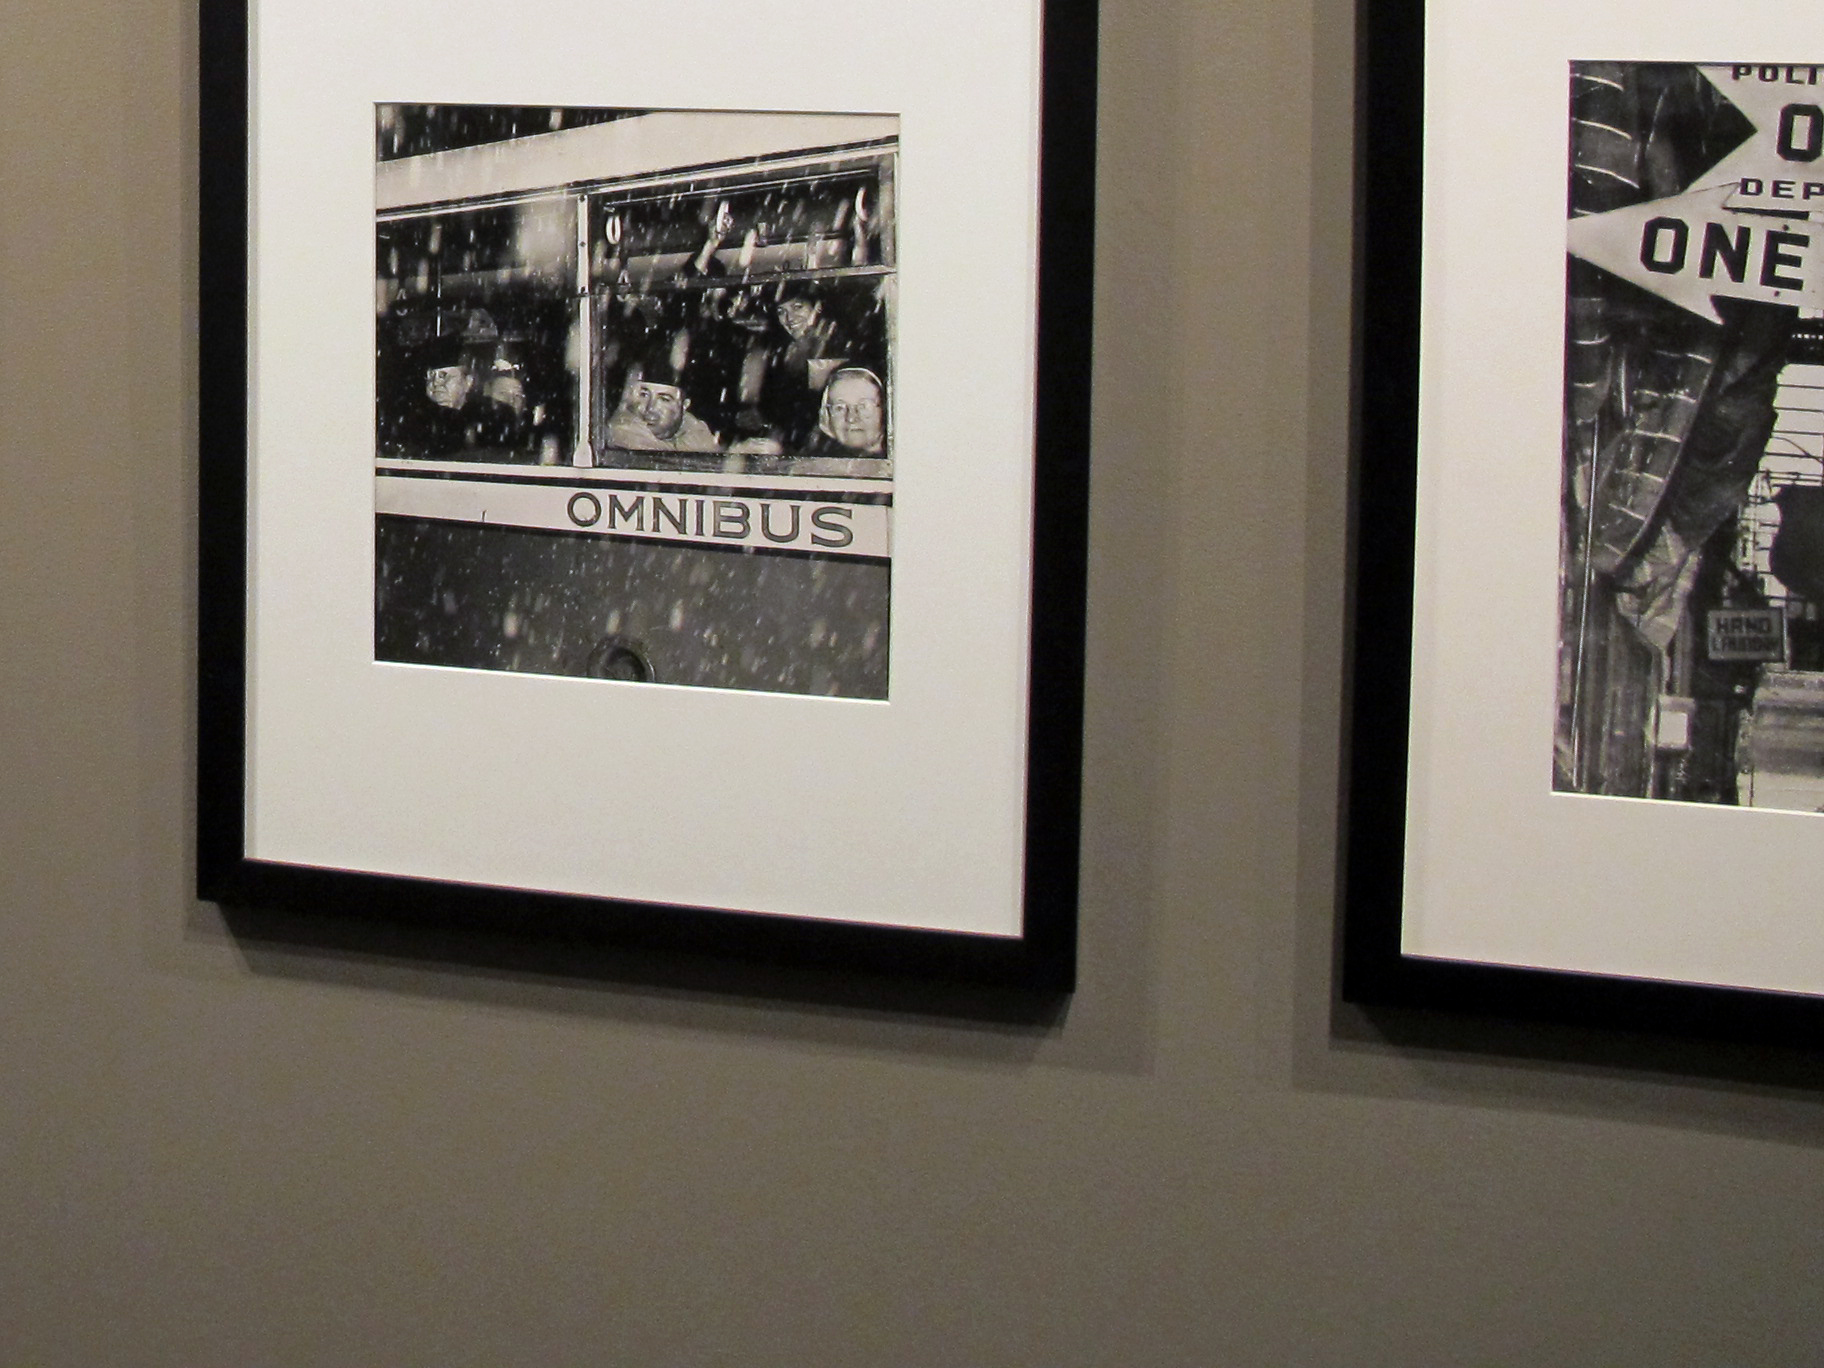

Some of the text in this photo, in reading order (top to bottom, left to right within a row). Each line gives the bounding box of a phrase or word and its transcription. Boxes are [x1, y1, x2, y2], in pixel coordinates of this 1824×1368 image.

[1739, 177, 1824, 201] DEP
[1639, 215, 1811, 292] ONE
[567, 491, 855, 549] OMNIBUS
